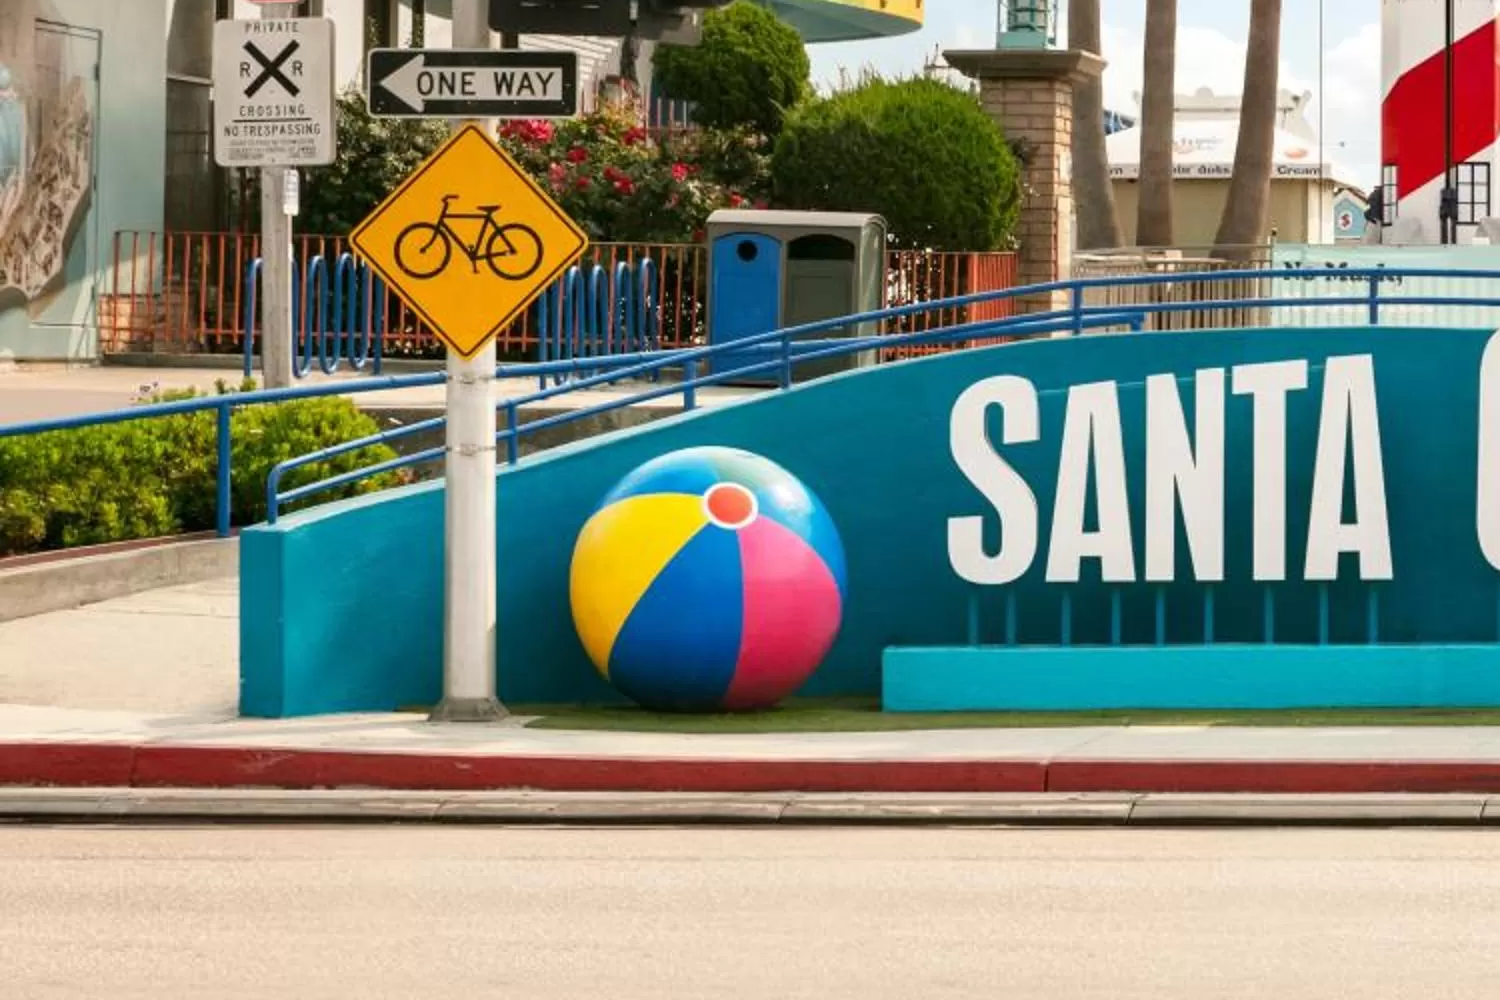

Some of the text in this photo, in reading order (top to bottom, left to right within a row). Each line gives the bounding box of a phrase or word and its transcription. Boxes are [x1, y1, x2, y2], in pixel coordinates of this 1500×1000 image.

[244, 20, 300, 33] PRIVATE
[416, 70, 555, 97] ONE WAY
[239, 103, 306, 117] CROSSING
[223, 122, 321, 137] NO TRESPASSING
[946, 352, 1394, 584] SANTA
